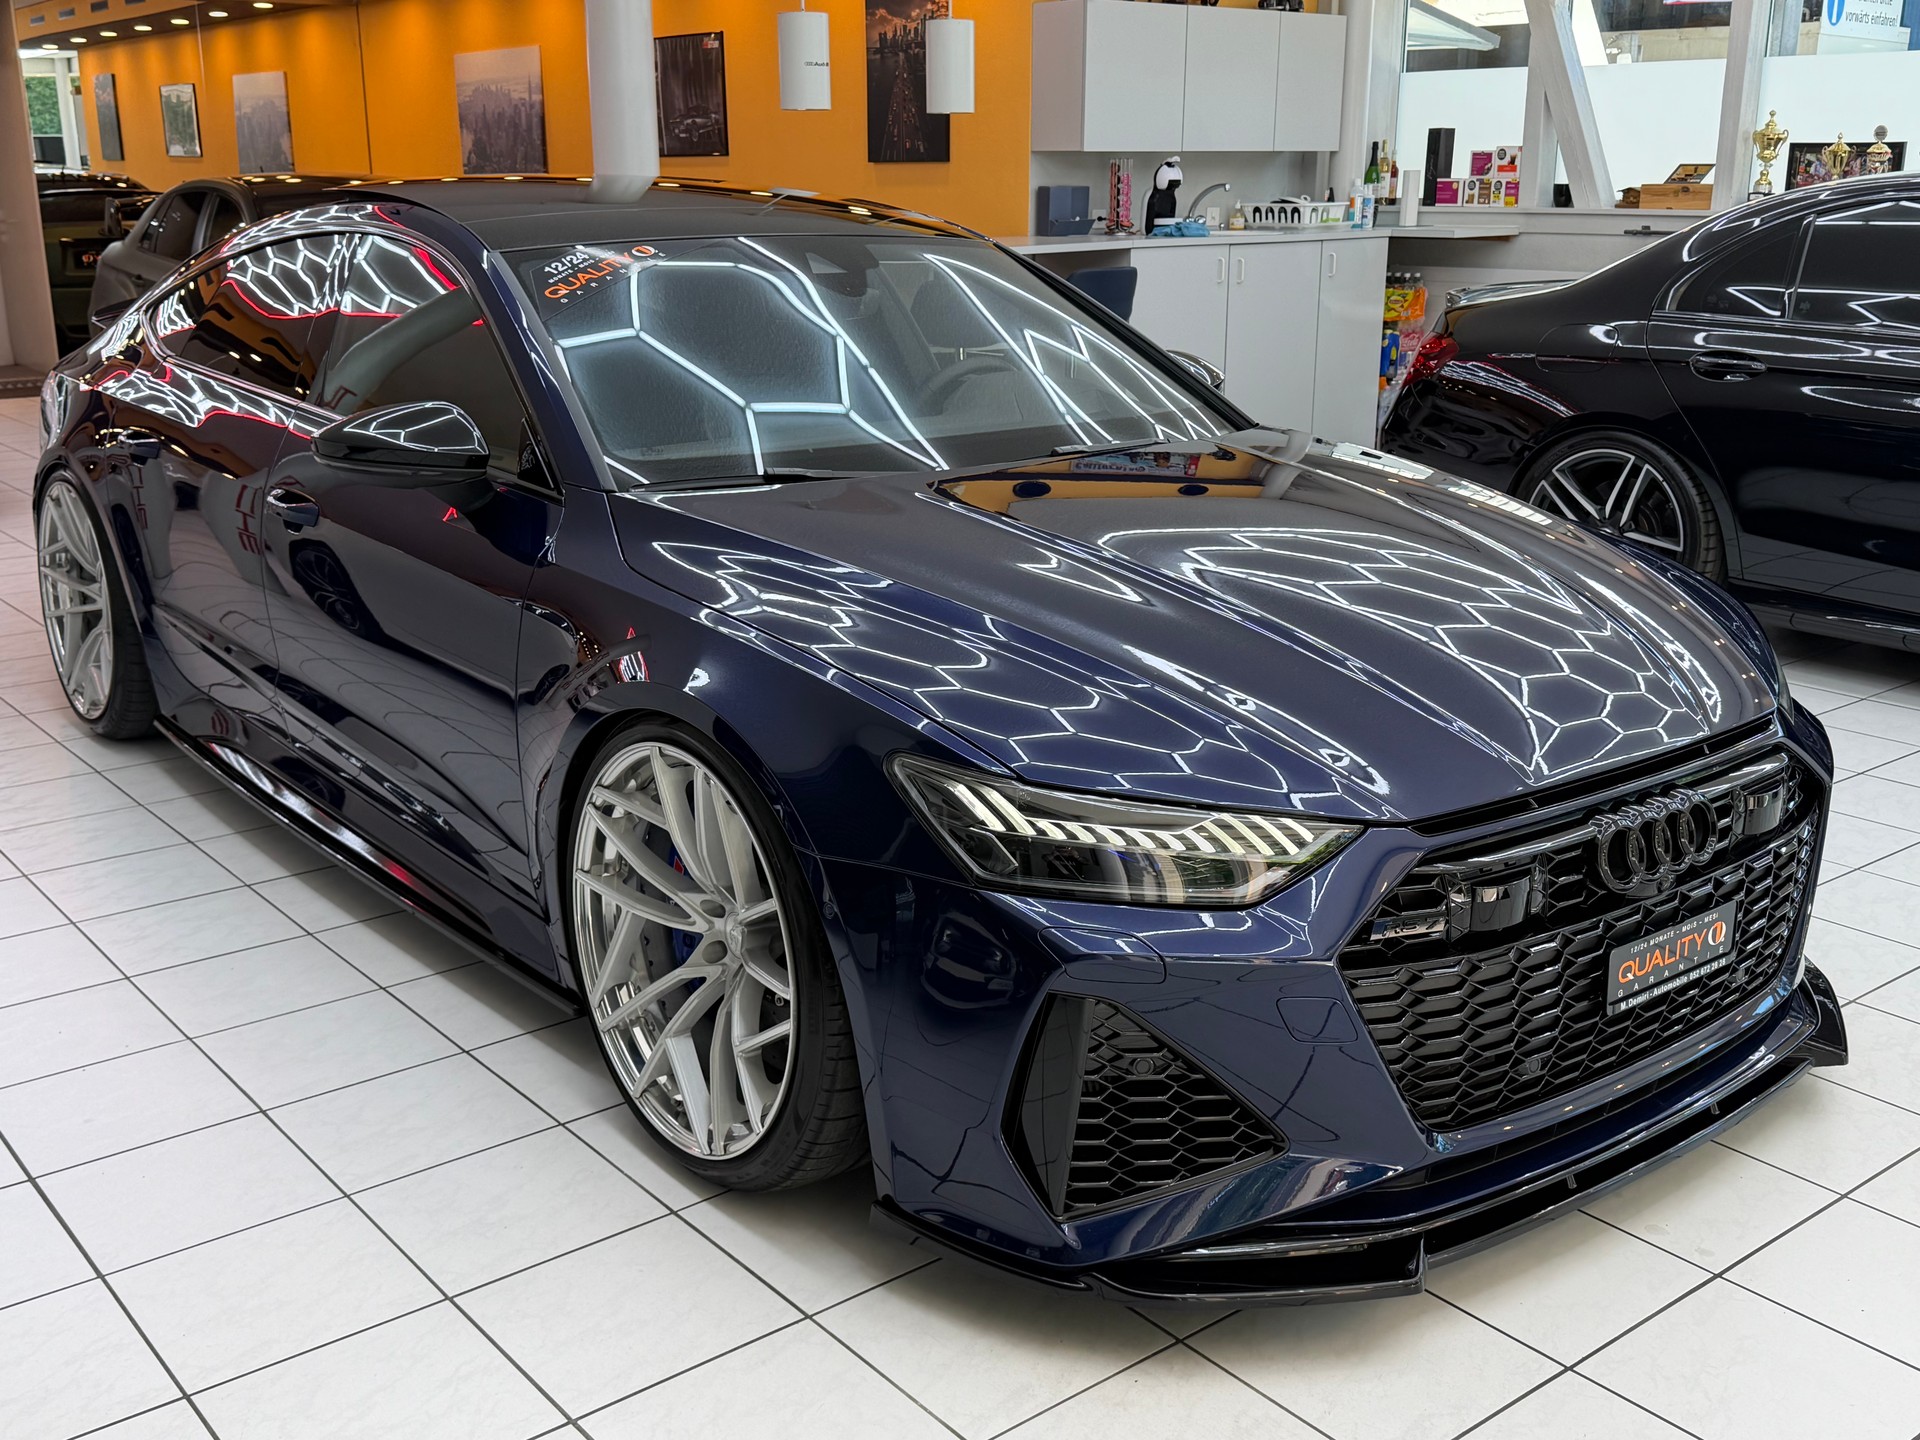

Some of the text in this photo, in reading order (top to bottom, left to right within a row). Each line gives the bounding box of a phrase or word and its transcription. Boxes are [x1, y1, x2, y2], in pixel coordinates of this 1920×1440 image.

[1845, 9, 1899, 27] vorwärts einfahren!
[544, 251, 589, 274] 12/24
[544, 252, 635, 299] QUALITY
[548, 269, 574, 283] MONATE
[1630, 942, 1648, 954] 12/24
[1649, 930, 1675, 946] MONATE
[1682, 921, 1697, 933] MOIS
[1704, 912, 1719, 923] MESI
[1617, 945, 1724, 997] GARANTIE
[1618, 928, 1708, 984] QUALITY
[1620, 1002, 1628, 1011] M.
[1628, 993, 1649, 1007] Demiri
[1653, 976, 1688, 997] Automobile
